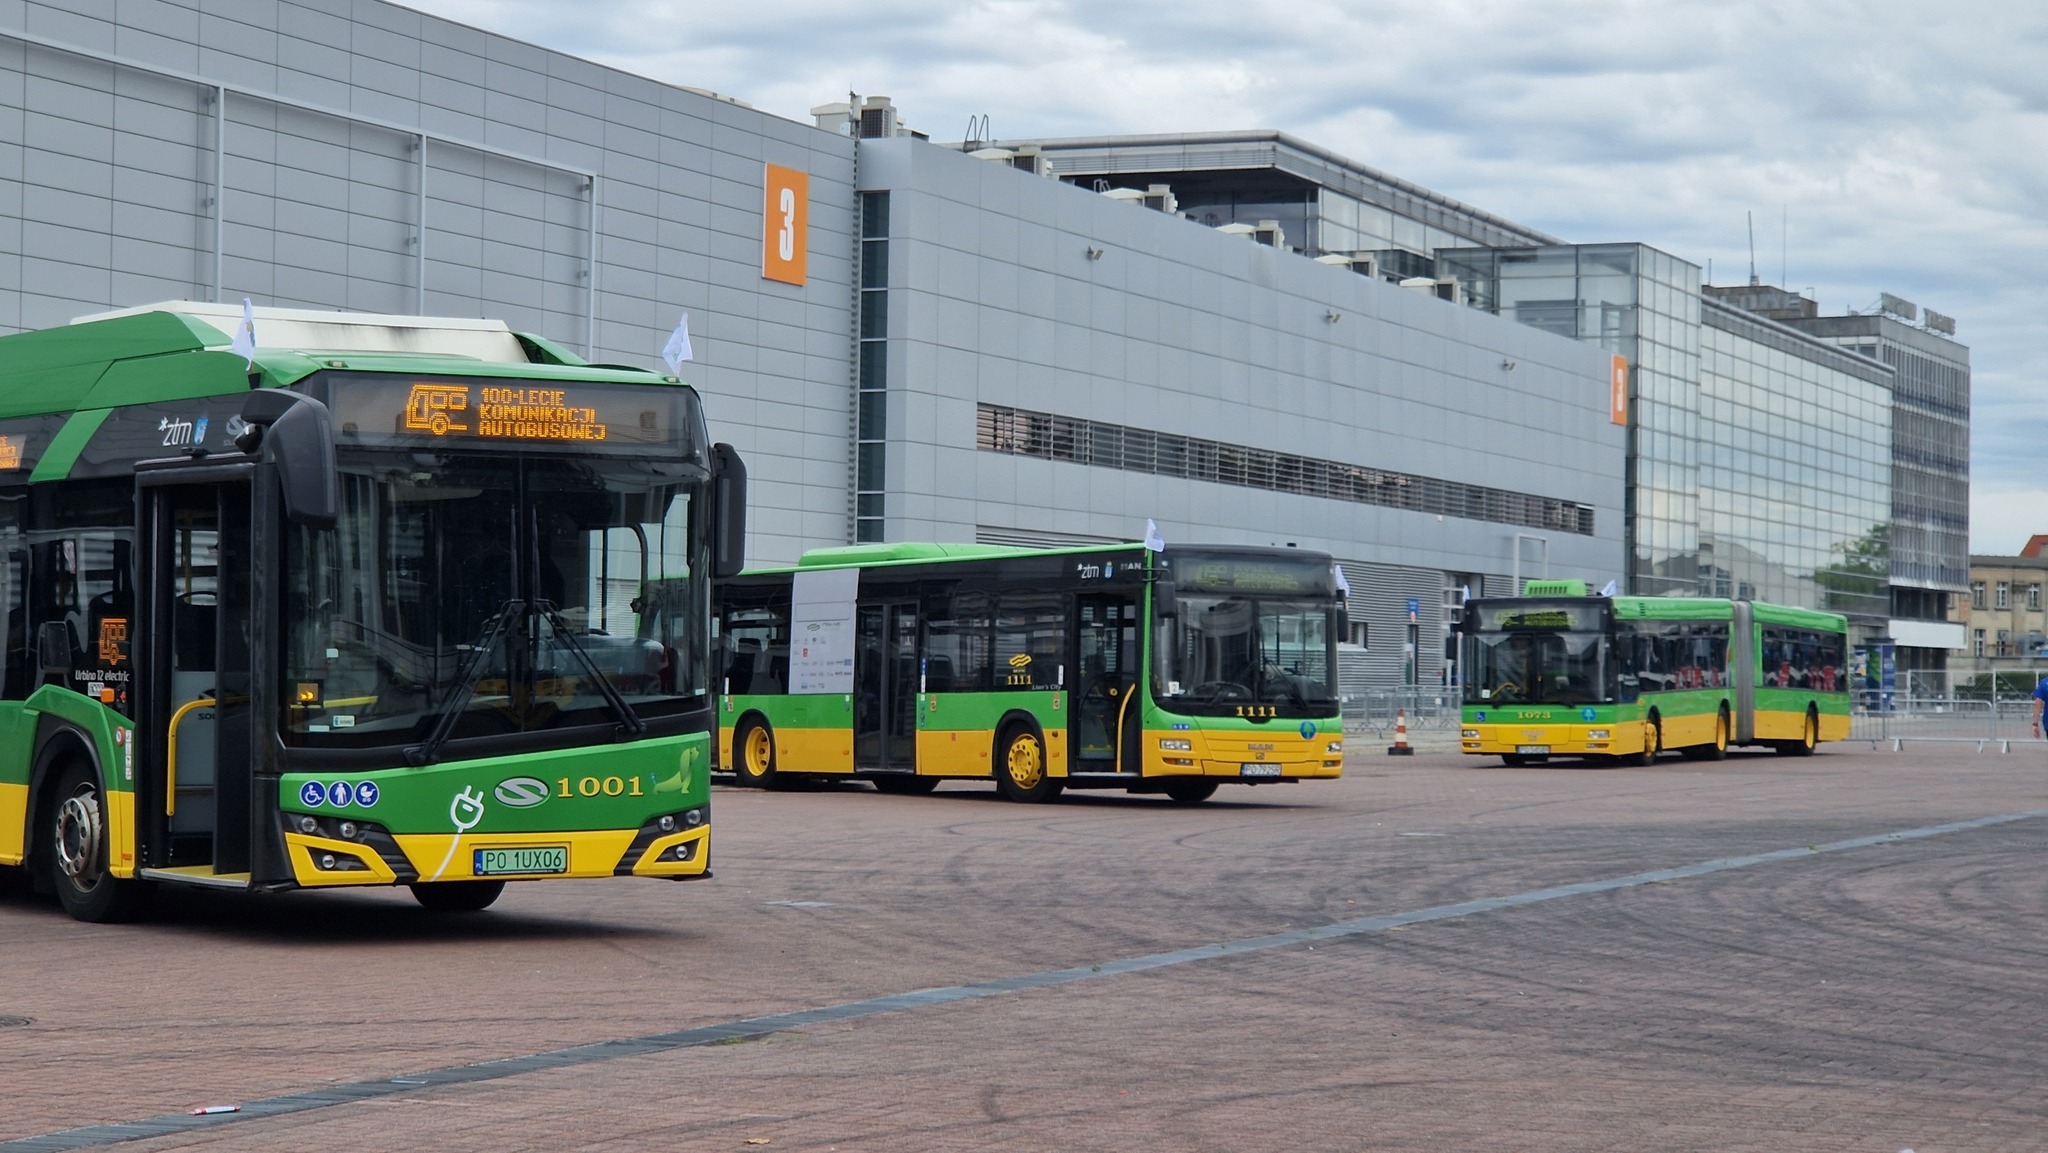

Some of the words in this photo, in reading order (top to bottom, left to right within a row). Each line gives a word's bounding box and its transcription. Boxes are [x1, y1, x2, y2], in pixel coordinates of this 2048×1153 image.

[780, 187, 795, 262] 3
[481, 387, 565, 406] 100-LECIE
[480, 403, 596, 424] KOMUNIKACJI
[479, 420, 606, 440] AUTOBUSOWEJ
[74, 669, 97, 681] Urbino
[97, 669, 104, 681] 12
[104, 669, 130, 682] electric
[1007, 674, 1033, 686] 1111
[1236, 705, 1278, 717] 1111
[557, 776, 644, 798] 1001
[514, 850, 562, 869] 1UX06
